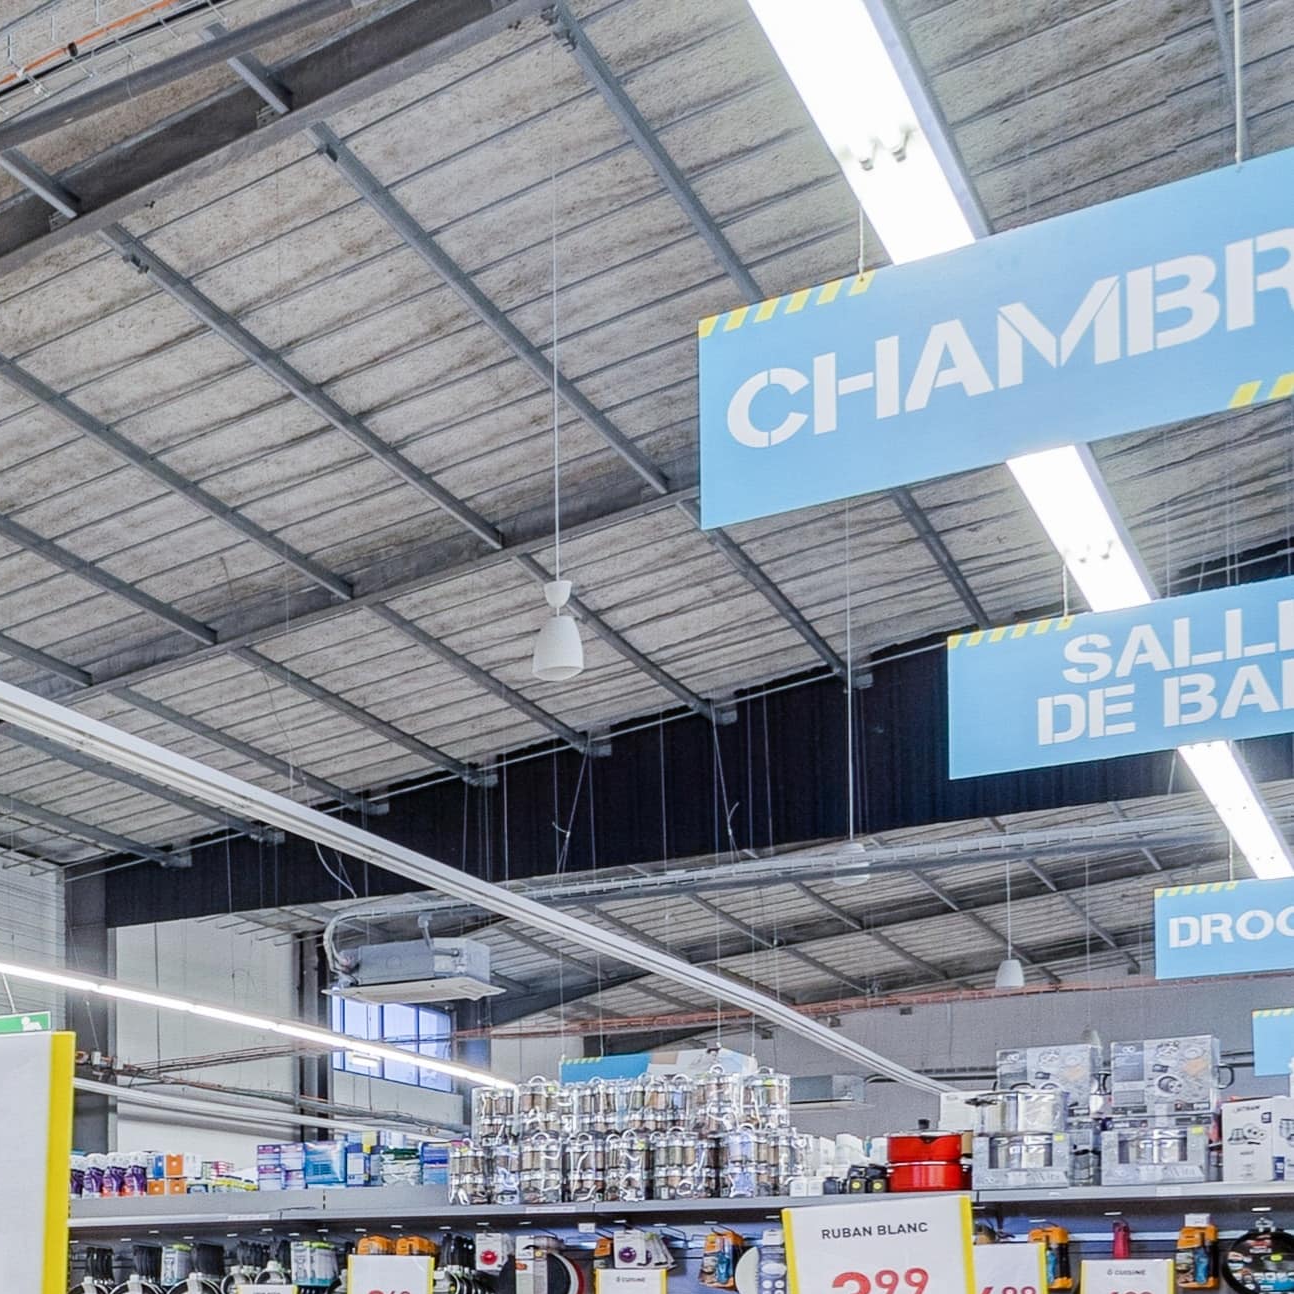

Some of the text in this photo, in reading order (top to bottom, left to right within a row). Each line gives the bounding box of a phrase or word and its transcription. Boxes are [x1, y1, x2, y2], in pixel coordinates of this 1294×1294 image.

[1037, 683, 1136, 745] DE
[821, 1222, 929, 1239] RUBAN BLANC
